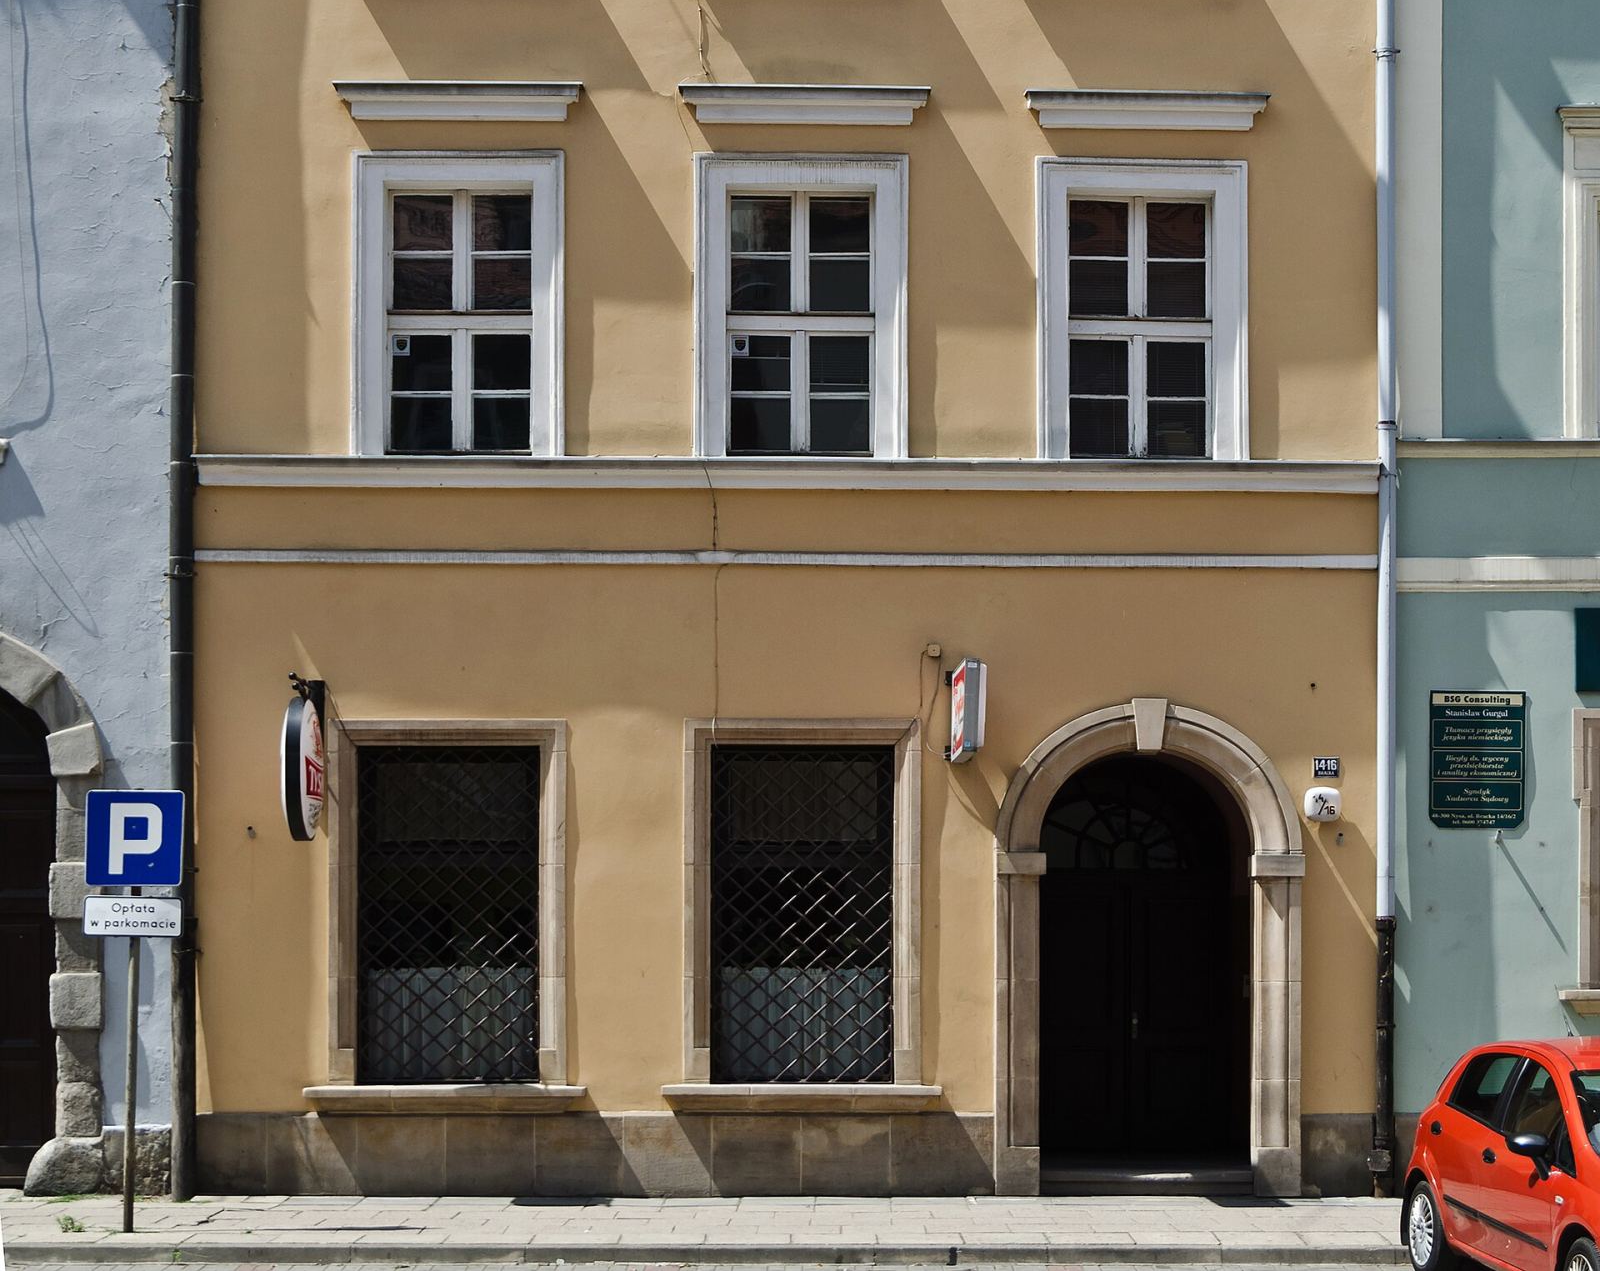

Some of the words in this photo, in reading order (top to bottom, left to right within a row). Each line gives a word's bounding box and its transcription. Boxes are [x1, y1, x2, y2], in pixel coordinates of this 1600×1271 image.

[1444, 695, 1461, 703] BSG
[1463, 695, 1511, 705] Consulting
[1482, 709, 1508, 718] Gurgul
[1467, 734, 1513, 742] niemieckiego
[1469, 770, 1517, 778] ekonomicznej
[1463, 788, 1491, 796] Syndyk
[108, 802, 163, 875] P
[111, 902, 156, 915] Opłata
[90, 919, 99, 927] w
[104, 918, 176, 930] parkomacie
